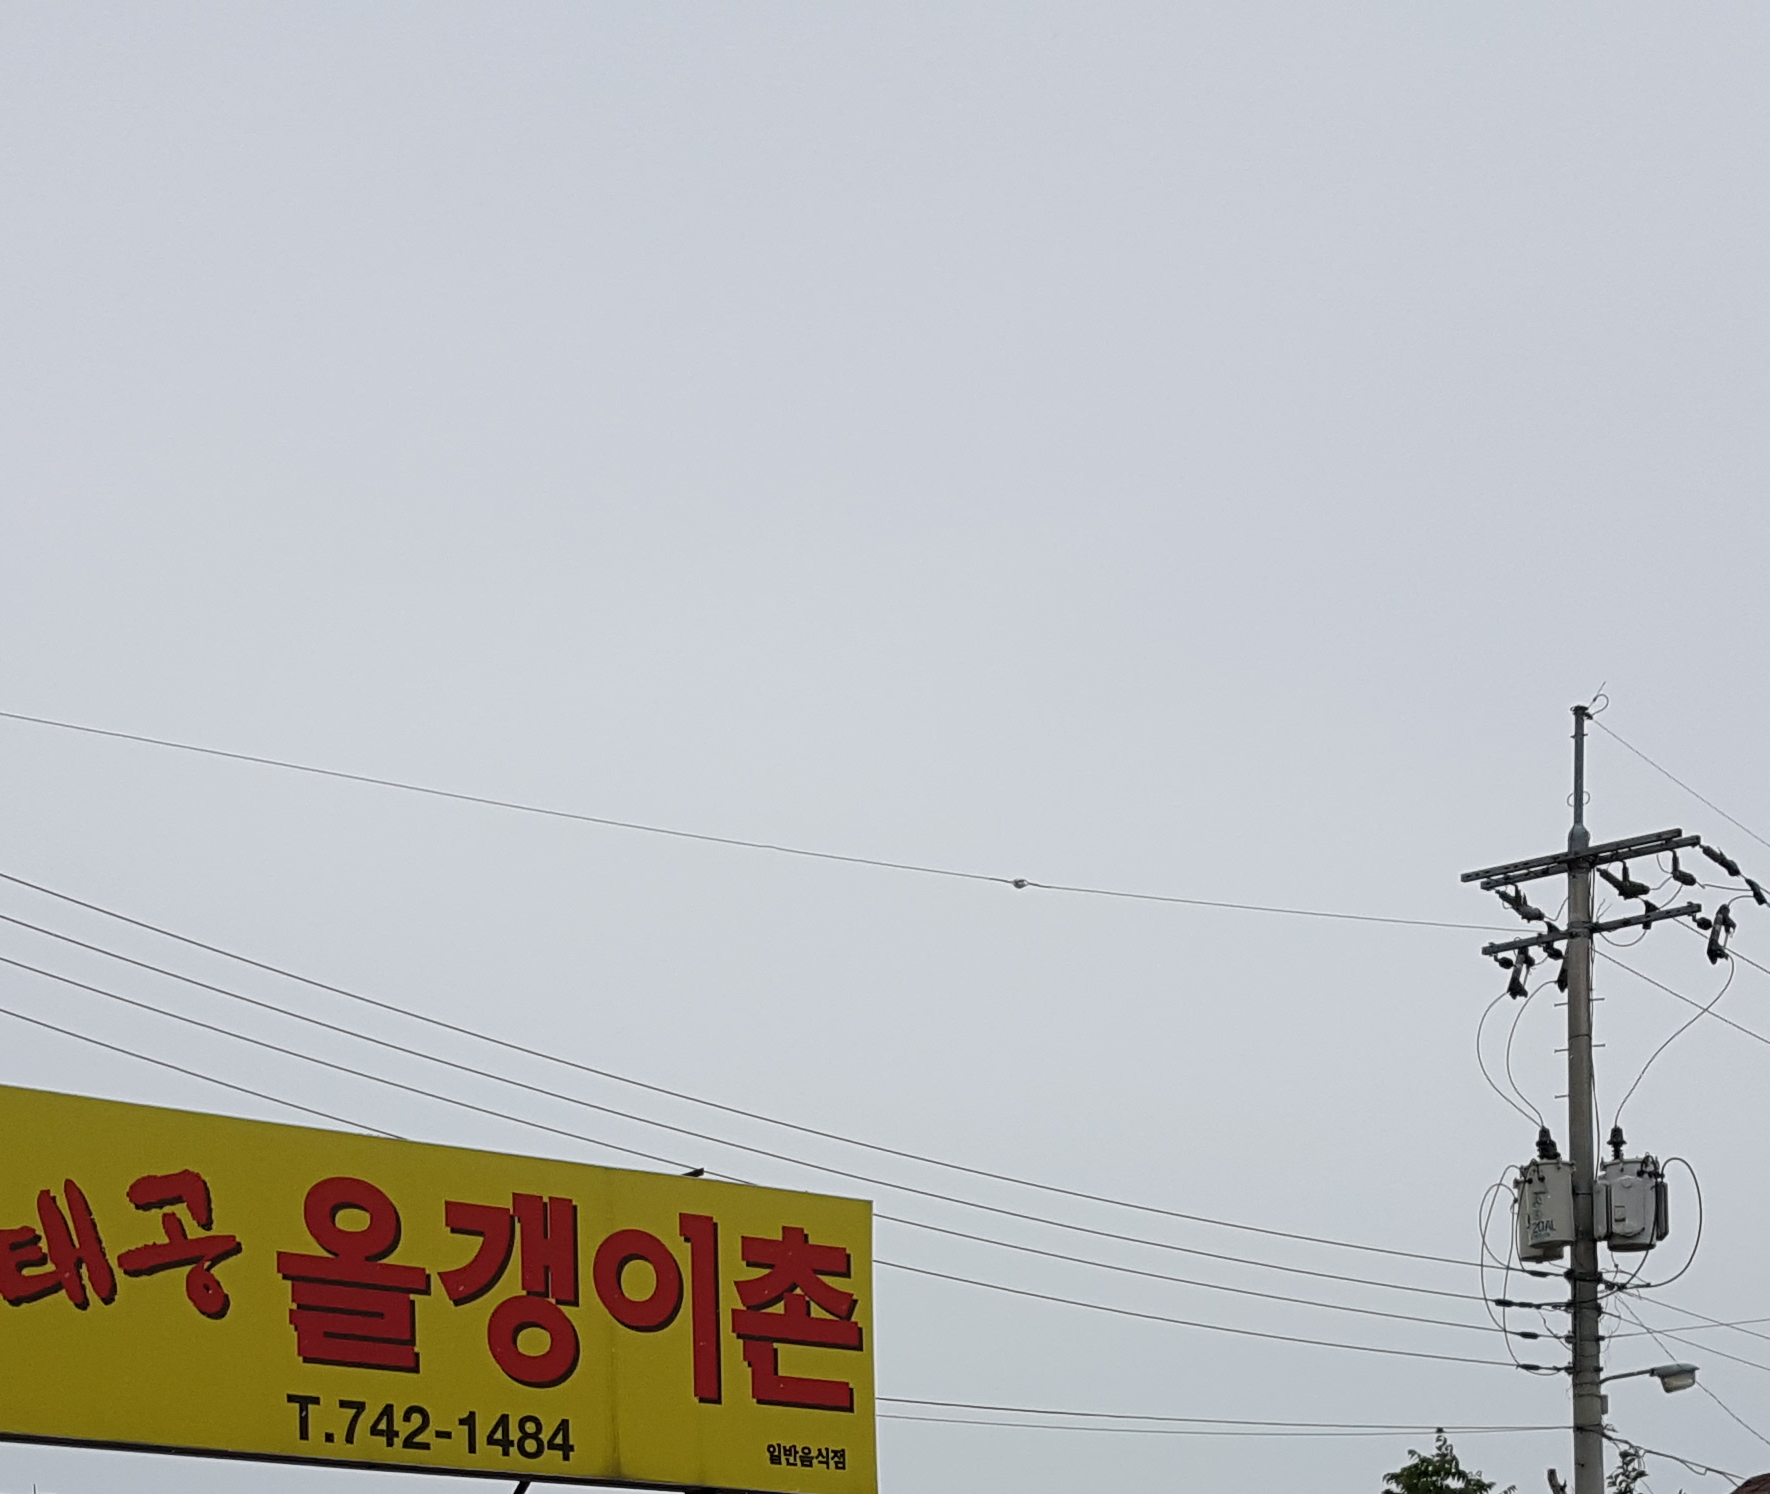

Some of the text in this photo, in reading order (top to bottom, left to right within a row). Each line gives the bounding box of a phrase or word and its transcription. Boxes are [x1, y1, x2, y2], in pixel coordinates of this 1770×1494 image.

[276, 1175, 864, 1412] 올갱이촌
[286, 1393, 575, 1462] T.742-1484
[766, 1442, 847, 1471] 일반음식점
